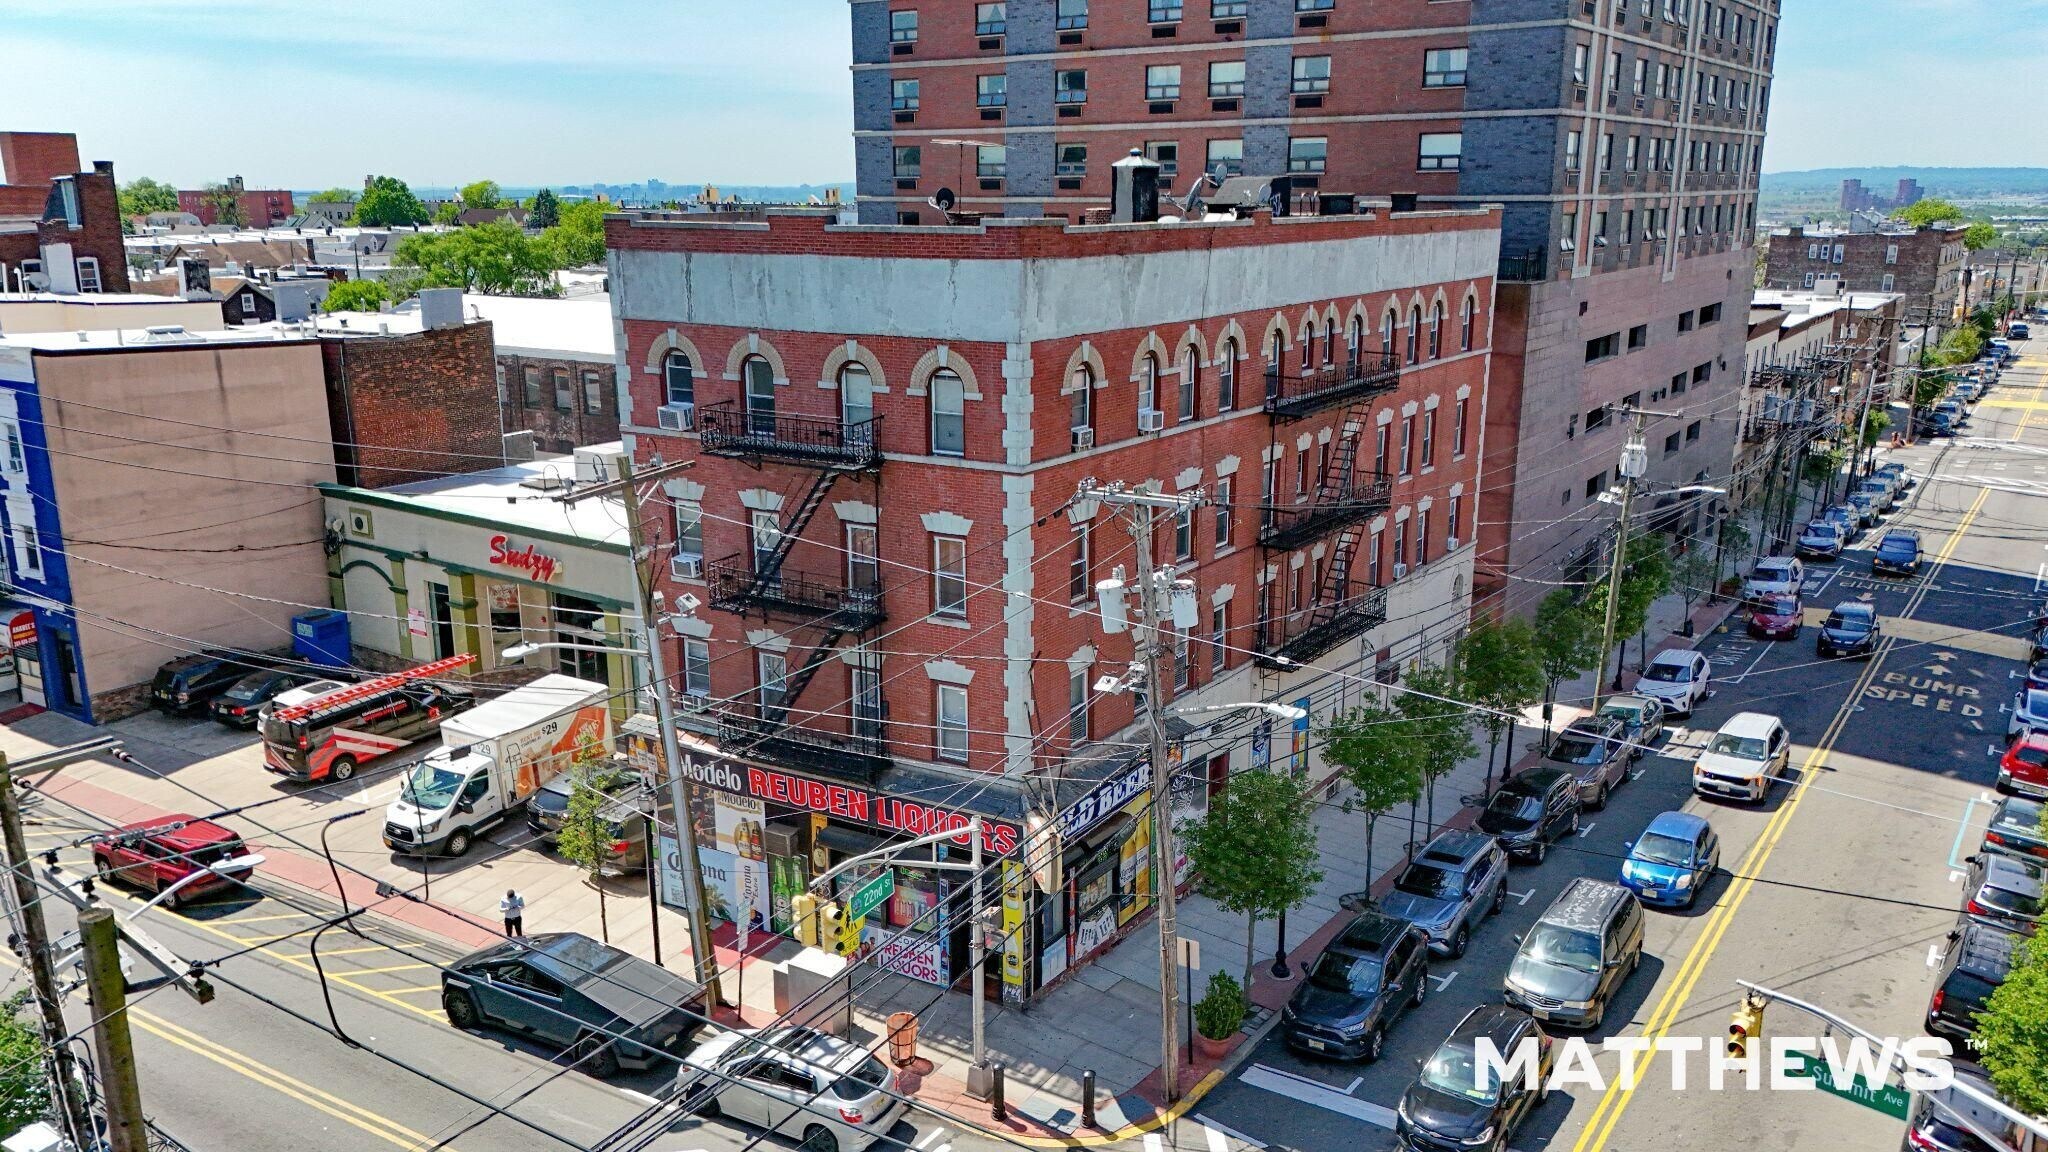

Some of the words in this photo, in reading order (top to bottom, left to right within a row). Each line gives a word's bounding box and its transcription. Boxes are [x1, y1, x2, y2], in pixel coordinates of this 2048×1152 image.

[489, 534, 556, 581] Sudzy
[1883, 671, 1981, 698] BUMP
[1865, 685, 1983, 717] SPEED
[681, 753, 742, 792] Modelo
[721, 792, 756, 810] Modelo
[1098, 763, 1149, 817] BEER
[748, 767, 869, 822] REUBEN
[876, 795, 1018, 857] LIQUORS
[863, 883, 883, 907] 22nd
[1883, 1091, 1904, 1107] Ave
